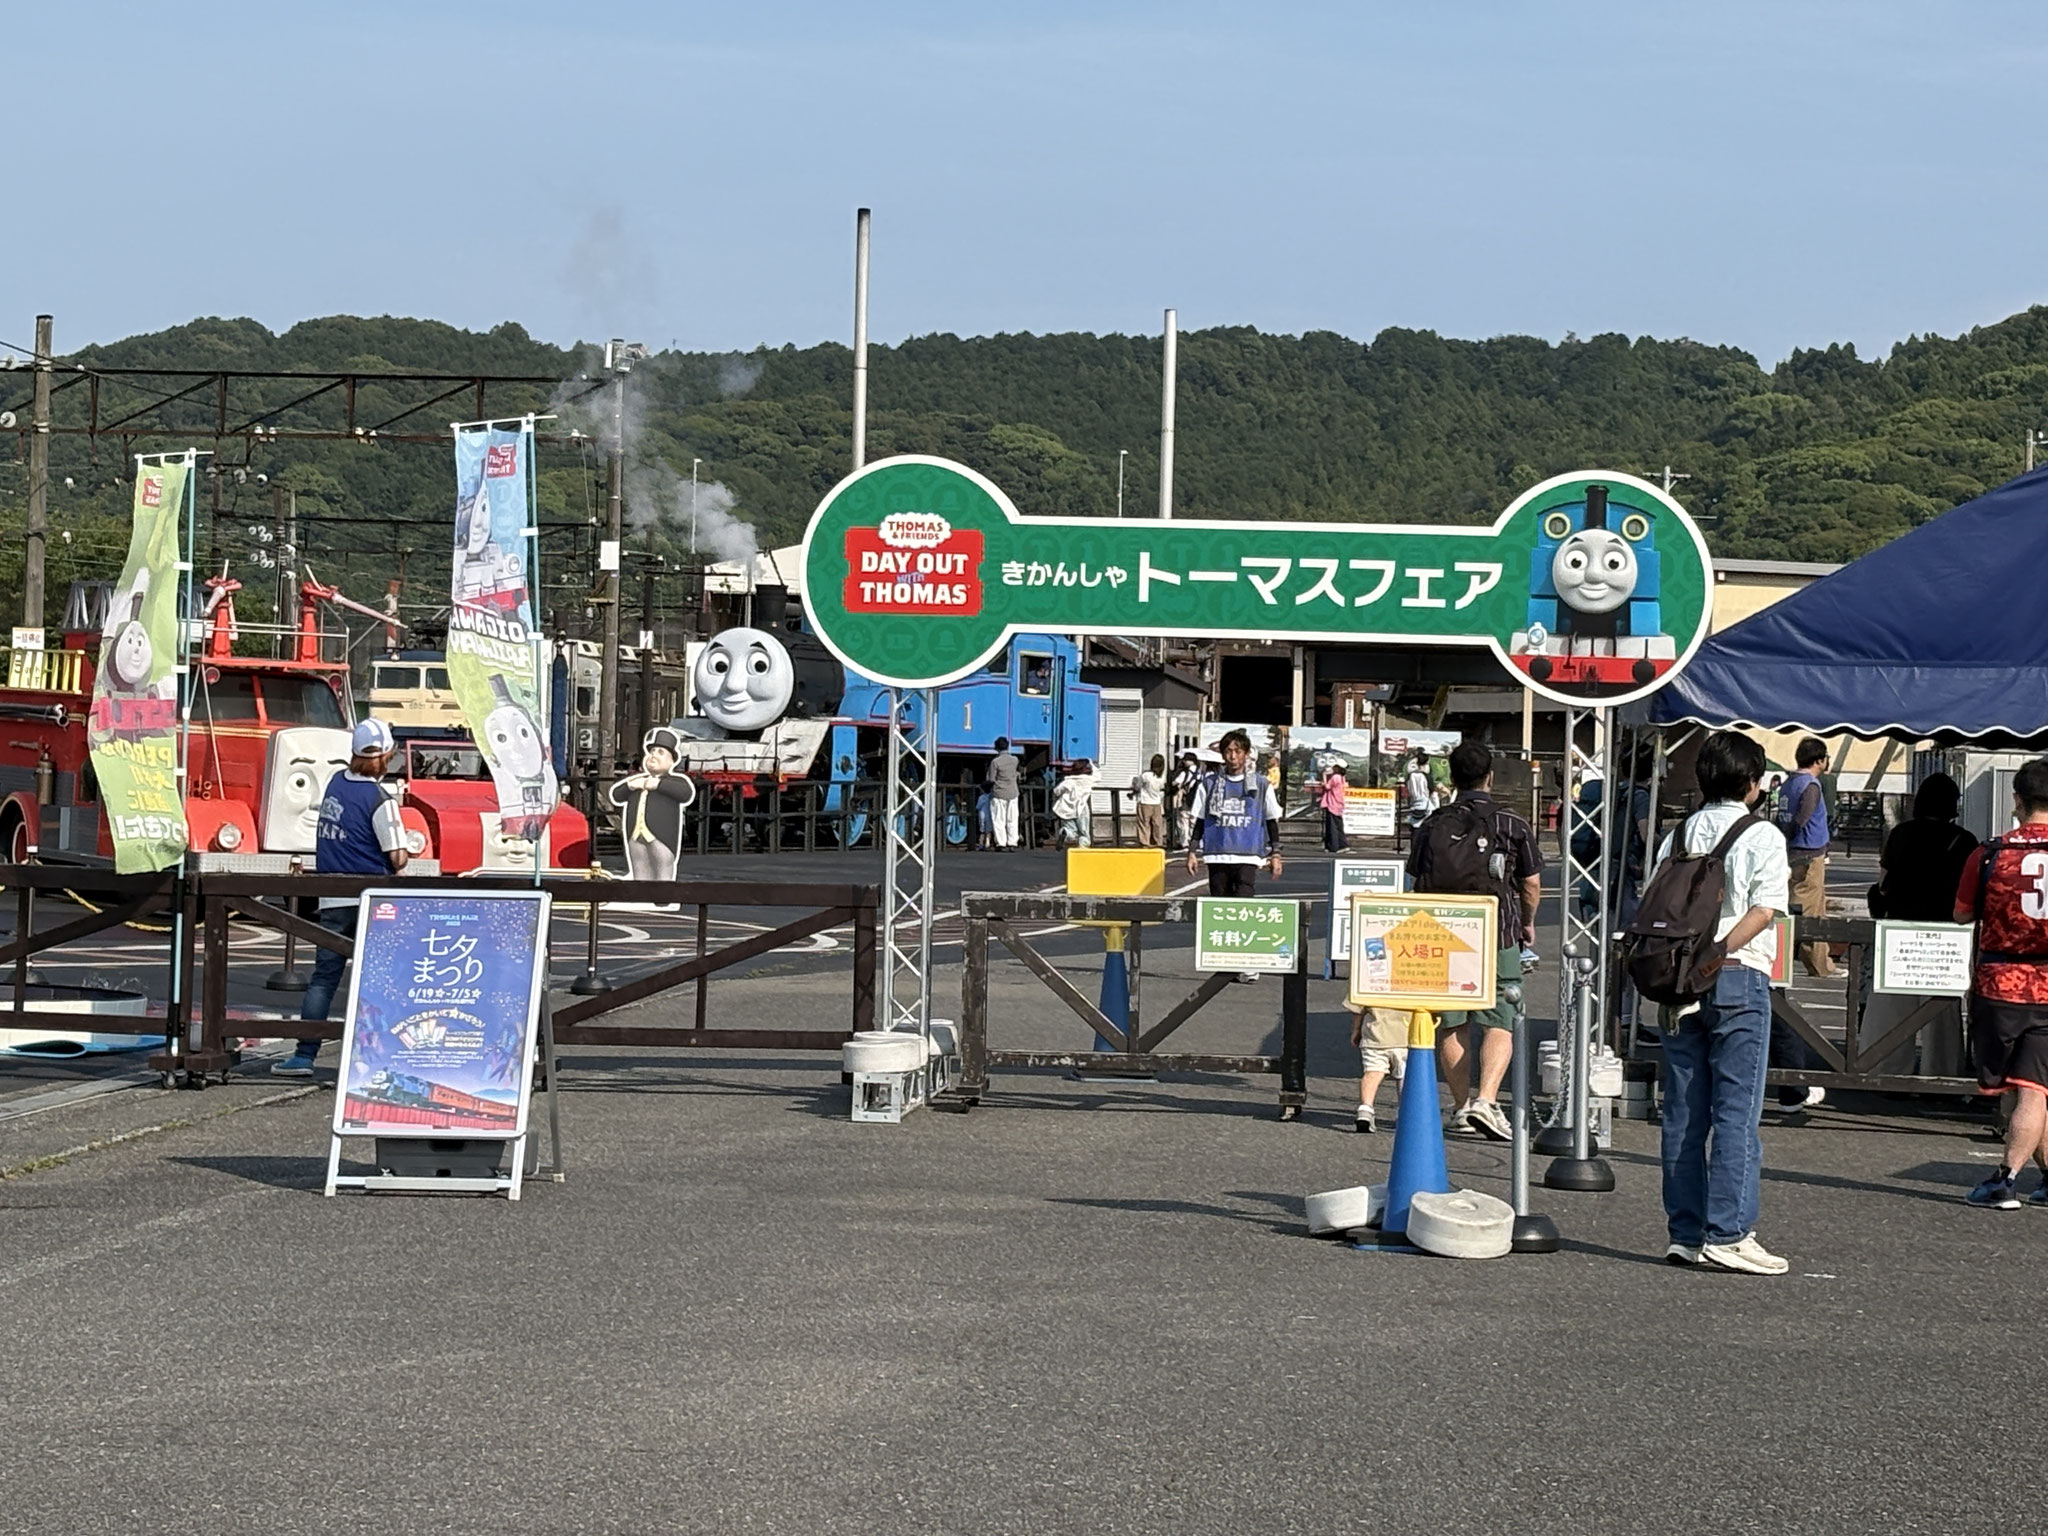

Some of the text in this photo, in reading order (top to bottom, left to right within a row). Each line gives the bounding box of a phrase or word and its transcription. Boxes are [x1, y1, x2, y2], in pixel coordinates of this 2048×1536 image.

[888, 521, 943, 532] THOMAS
[901, 532, 940, 540] FRIENDS
[861, 551, 969, 575] DAY OUT
[860, 581, 967, 605] THOMAS
[963, 702, 972, 731] 1
[1216, 815, 1252, 828] STAFF
[1213, 906, 1284, 923] ここから先
[421, 928, 478, 963] 七夕
[1209, 929, 1286, 947] 有料ゾーン
[1398, 944, 1444, 960] 入場口
[413, 955, 484, 987] まつり
